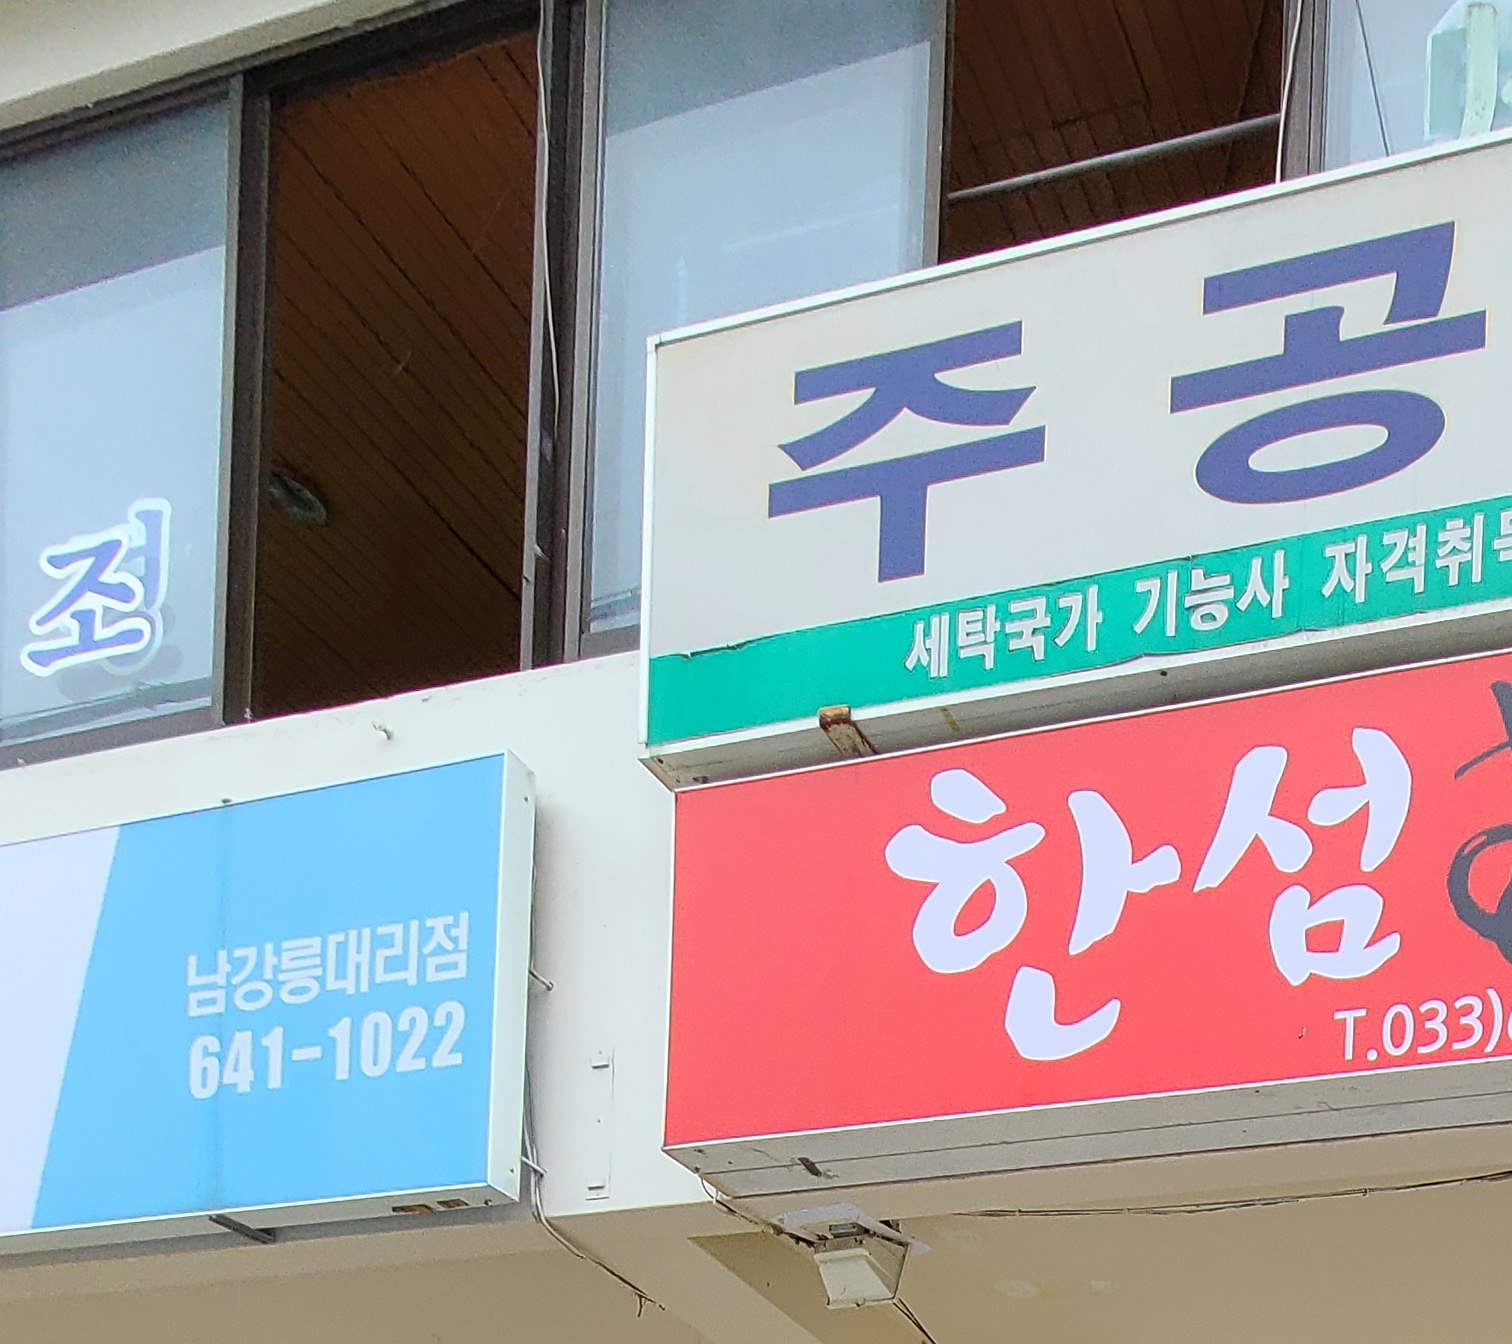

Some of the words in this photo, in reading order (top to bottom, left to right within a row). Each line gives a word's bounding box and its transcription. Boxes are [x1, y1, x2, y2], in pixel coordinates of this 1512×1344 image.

[903, 582, 1103, 681] 세탁국가
[1133, 550, 1291, 640] 기능사
[186, 911, 471, 1017] 남강릉대리점
[188, 1001, 466, 1100] 641-1022
